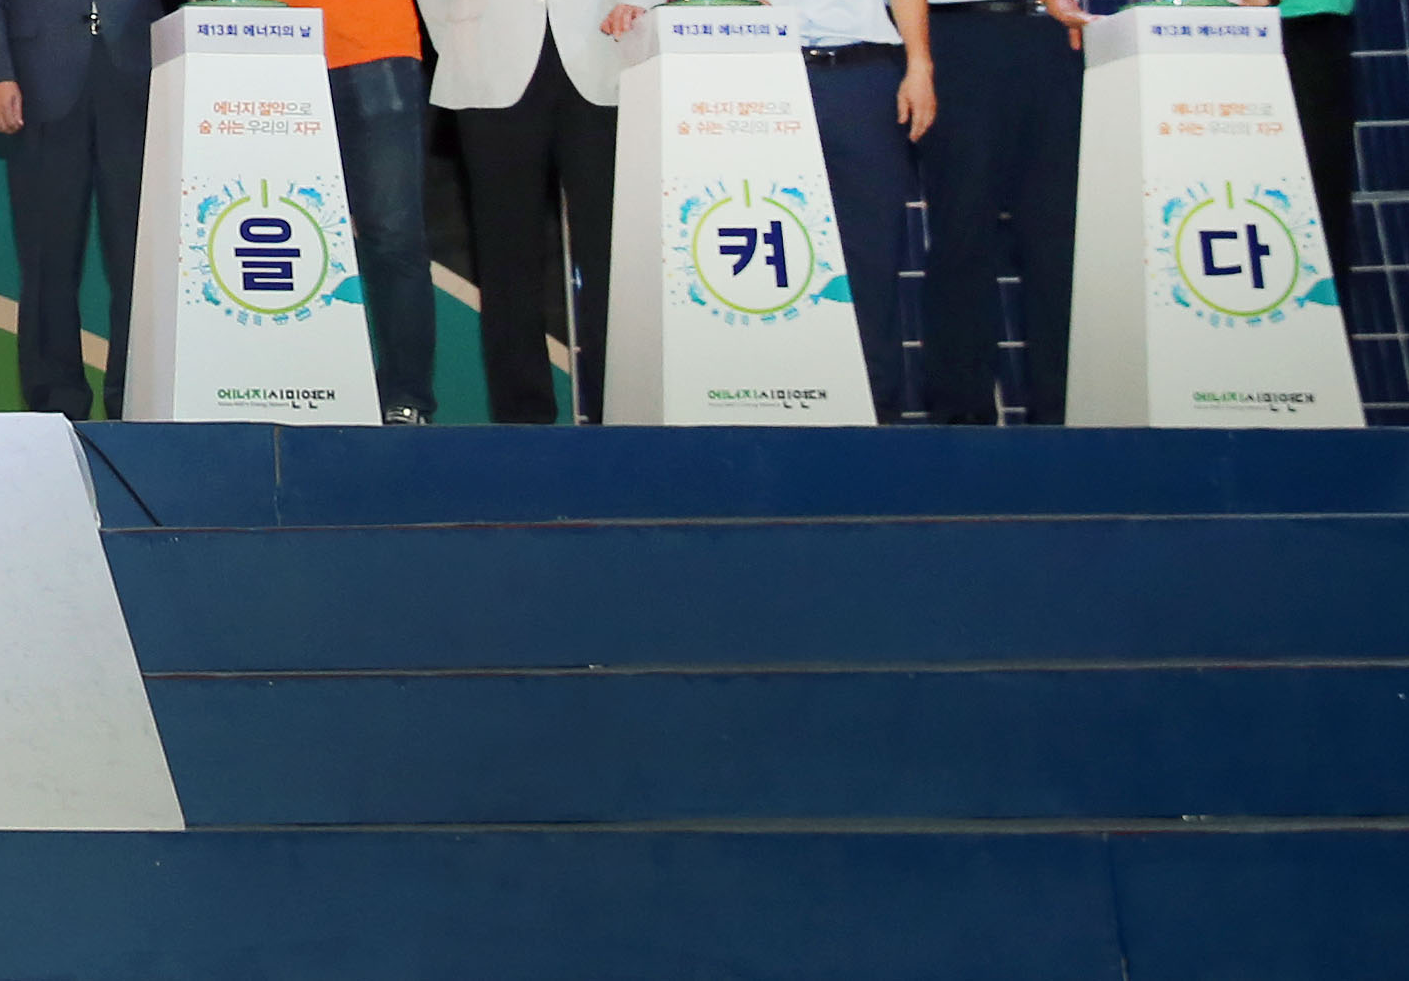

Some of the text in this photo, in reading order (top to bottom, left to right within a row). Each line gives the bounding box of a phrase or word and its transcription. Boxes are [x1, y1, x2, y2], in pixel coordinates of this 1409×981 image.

[197, 24, 311, 37] 제13회 에너지의 날
[214, 101, 312, 116] 에너지 절약으로
[217, 120, 245, 135] 쉬는
[247, 120, 289, 135] 우리의
[293, 120, 321, 135] 지구
[235, 218, 301, 291] 을
[718, 221, 789, 288] 켜
[1199, 224, 1270, 289] 다
[218, 389, 335, 409] 에너지시민연대
